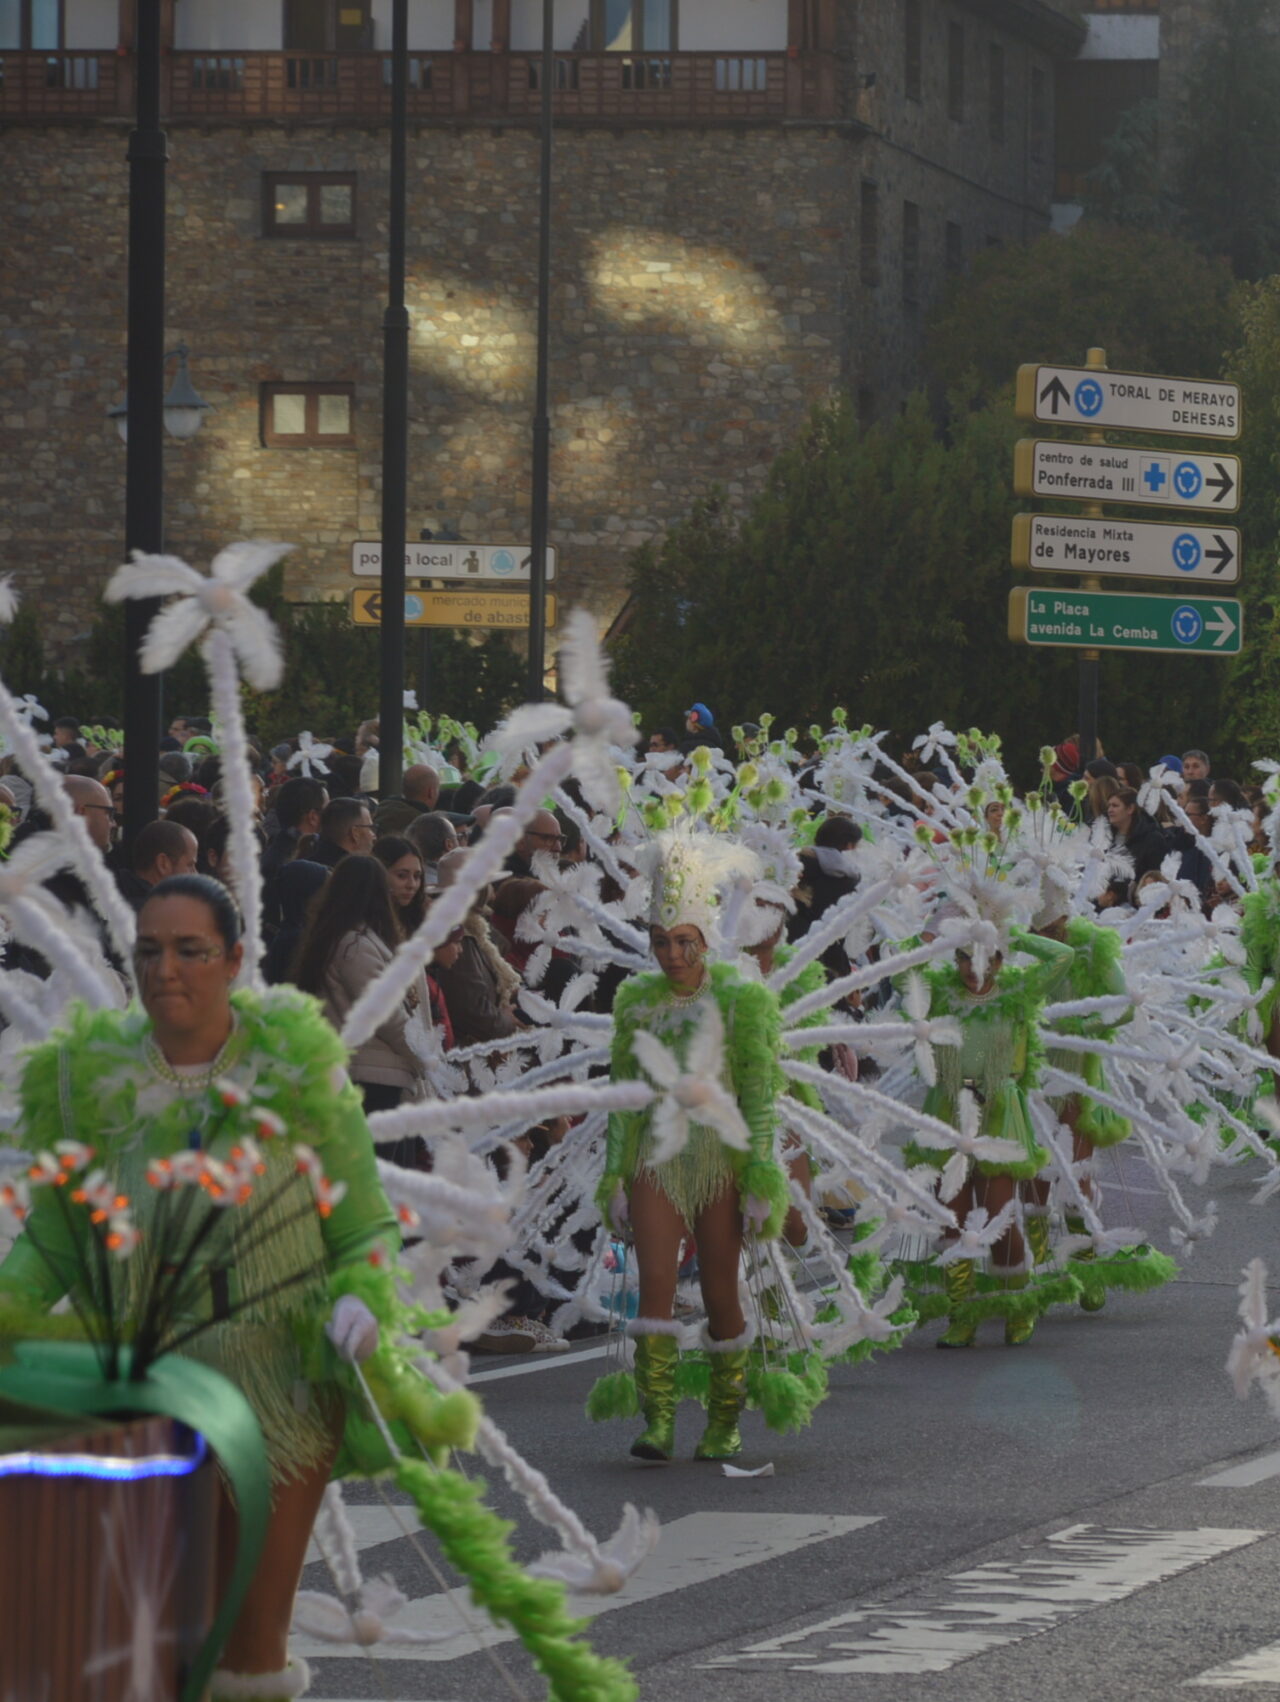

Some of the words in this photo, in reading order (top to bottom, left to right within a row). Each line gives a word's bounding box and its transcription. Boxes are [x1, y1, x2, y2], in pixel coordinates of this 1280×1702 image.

[1109, 383, 1152, 400] TORAL
[1159, 388, 1175, 402] DE
[1182, 391, 1236, 407] MERAYO
[1172, 410, 1235, 428] DEHESAS
[1039, 453, 1073, 465] centro
[1080, 454, 1093, 466] de
[1100, 457, 1128, 469] salud
[1038, 470, 1113, 490] Ponferrada
[1122, 477, 1135, 492] III
[1035, 523, 1096, 539] Residencia
[1103, 528, 1134, 541] Mixta
[417, 553, 453, 566] local
[1035, 542, 1054, 557] de
[1064, 543, 1130, 563] Mayores
[432, 595, 486, 607] mercado
[1030, 600, 1045, 614] La
[1054, 601, 1090, 616] Placa
[464, 610, 482, 622] de
[1030, 622, 1082, 636] avenida
[1090, 624, 1105, 637] La
[1113, 625, 1158, 640] Cemba
